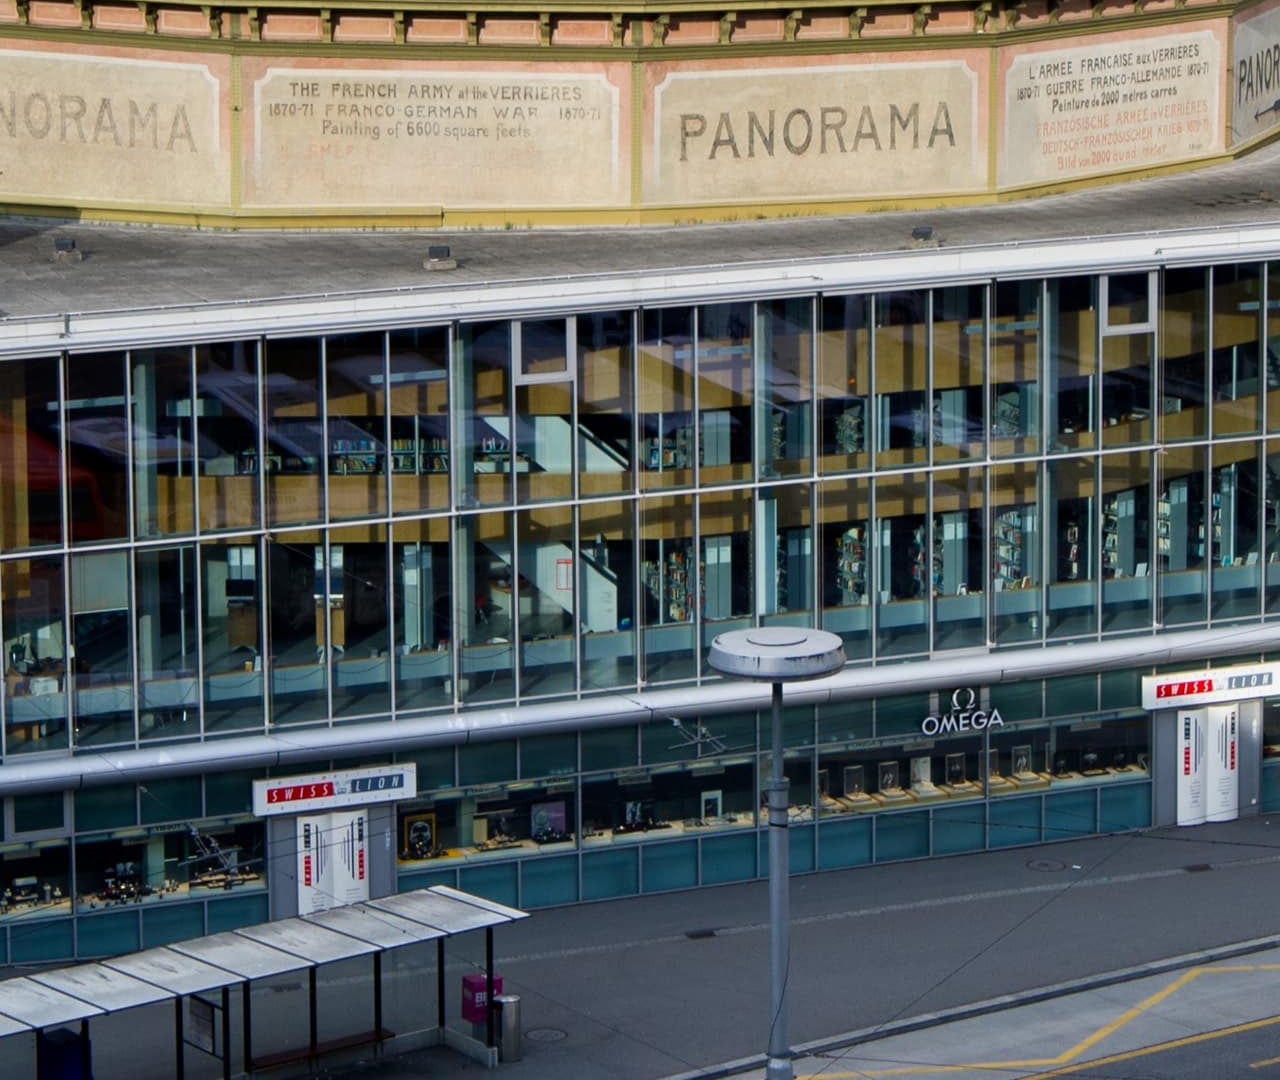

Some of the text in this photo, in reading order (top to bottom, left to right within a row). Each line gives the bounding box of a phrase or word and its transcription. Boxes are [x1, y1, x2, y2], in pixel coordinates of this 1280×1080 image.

[1136, 54, 1151, 64] aux
[289, 82, 320, 97] THE
[332, 83, 397, 98] FRENCH
[408, 84, 453, 99] ARMY
[458, 86, 468, 100] at
[473, 86, 488, 100] the
[1046, 81, 1084, 96] GUERRE
[1091, 66, 1182, 91] FRANCO-ALLEMANDE
[269, 103, 601, 120] 1870-71 FRANCO-GERMAN WAR 1870-71
[1052, 96, 1089, 114] Peinture
[1091, 98, 1100, 107] de
[1101, 91, 1119, 107] 2000
[322, 120, 380, 140] Painting
[387, 121, 403, 139] of
[407, 121, 440, 137] 6600
[444, 126, 489, 141] square
[679, 101, 956, 162] PANORAMA
[1057, 154, 1076, 170] Bild
[1091, 150, 1111, 165] 2000
[1160, 673, 1270, 697] SWISS LION
[922, 708, 1004, 735] OMEGA
[272, 783, 328, 802] SWISS
[356, 776, 399, 792] LION
